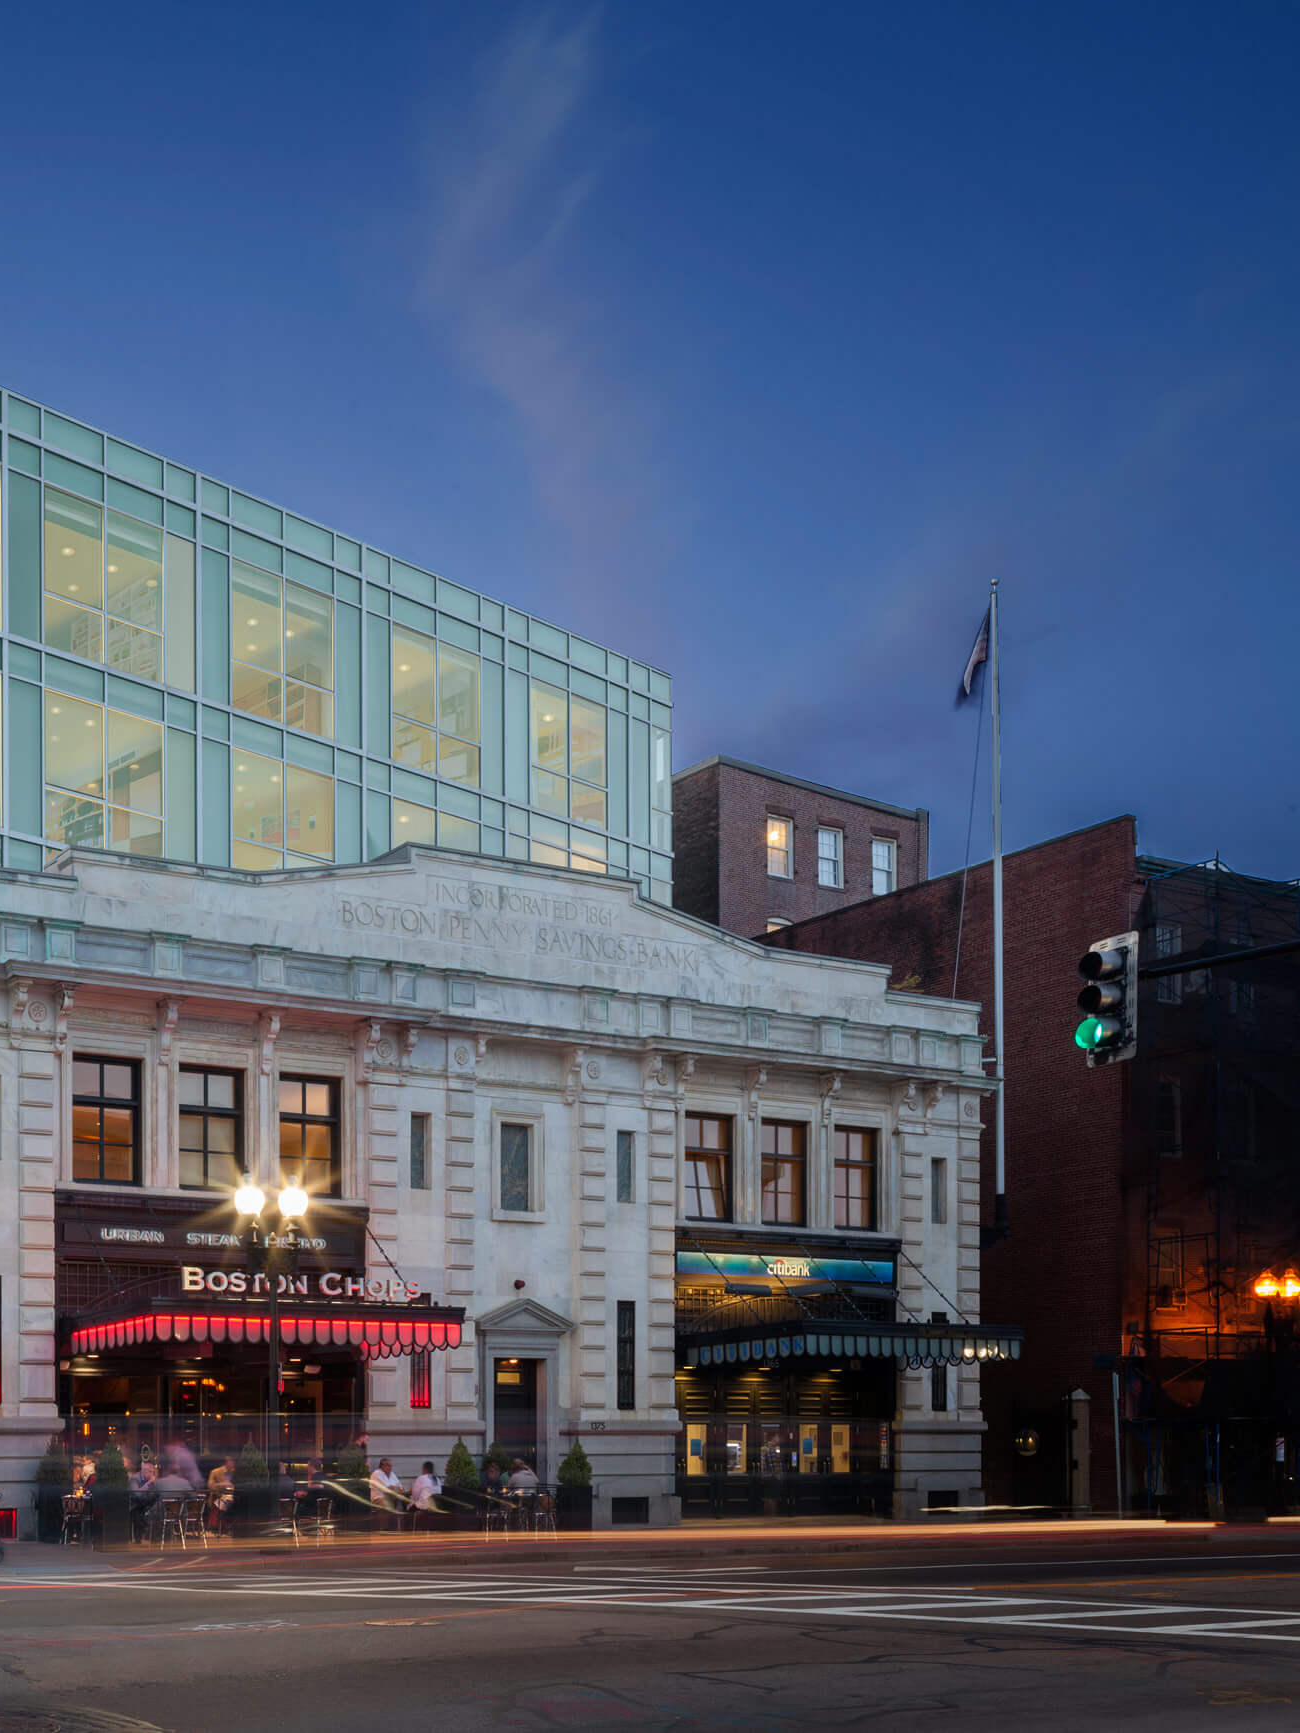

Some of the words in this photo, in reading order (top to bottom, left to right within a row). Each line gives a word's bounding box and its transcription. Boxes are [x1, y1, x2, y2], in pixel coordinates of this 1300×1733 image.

[435, 882, 579, 922] INCORPORATED
[584, 905, 613, 927] 1861
[341, 901, 437, 936] BOSTON
[449, 915, 527, 944] PENNY
[538, 928, 628, 962] SAVINGS
[636, 941, 698, 973] BANK
[100, 1227, 165, 1244] URBAN
[186, 1231, 244, 1247] STEAK
[181, 1266, 309, 1295] BOSTON
[318, 1271, 422, 1299] CHOPS
[766, 1259, 810, 1277] citibank
[700, 1336, 805, 1362] CITIBANK
